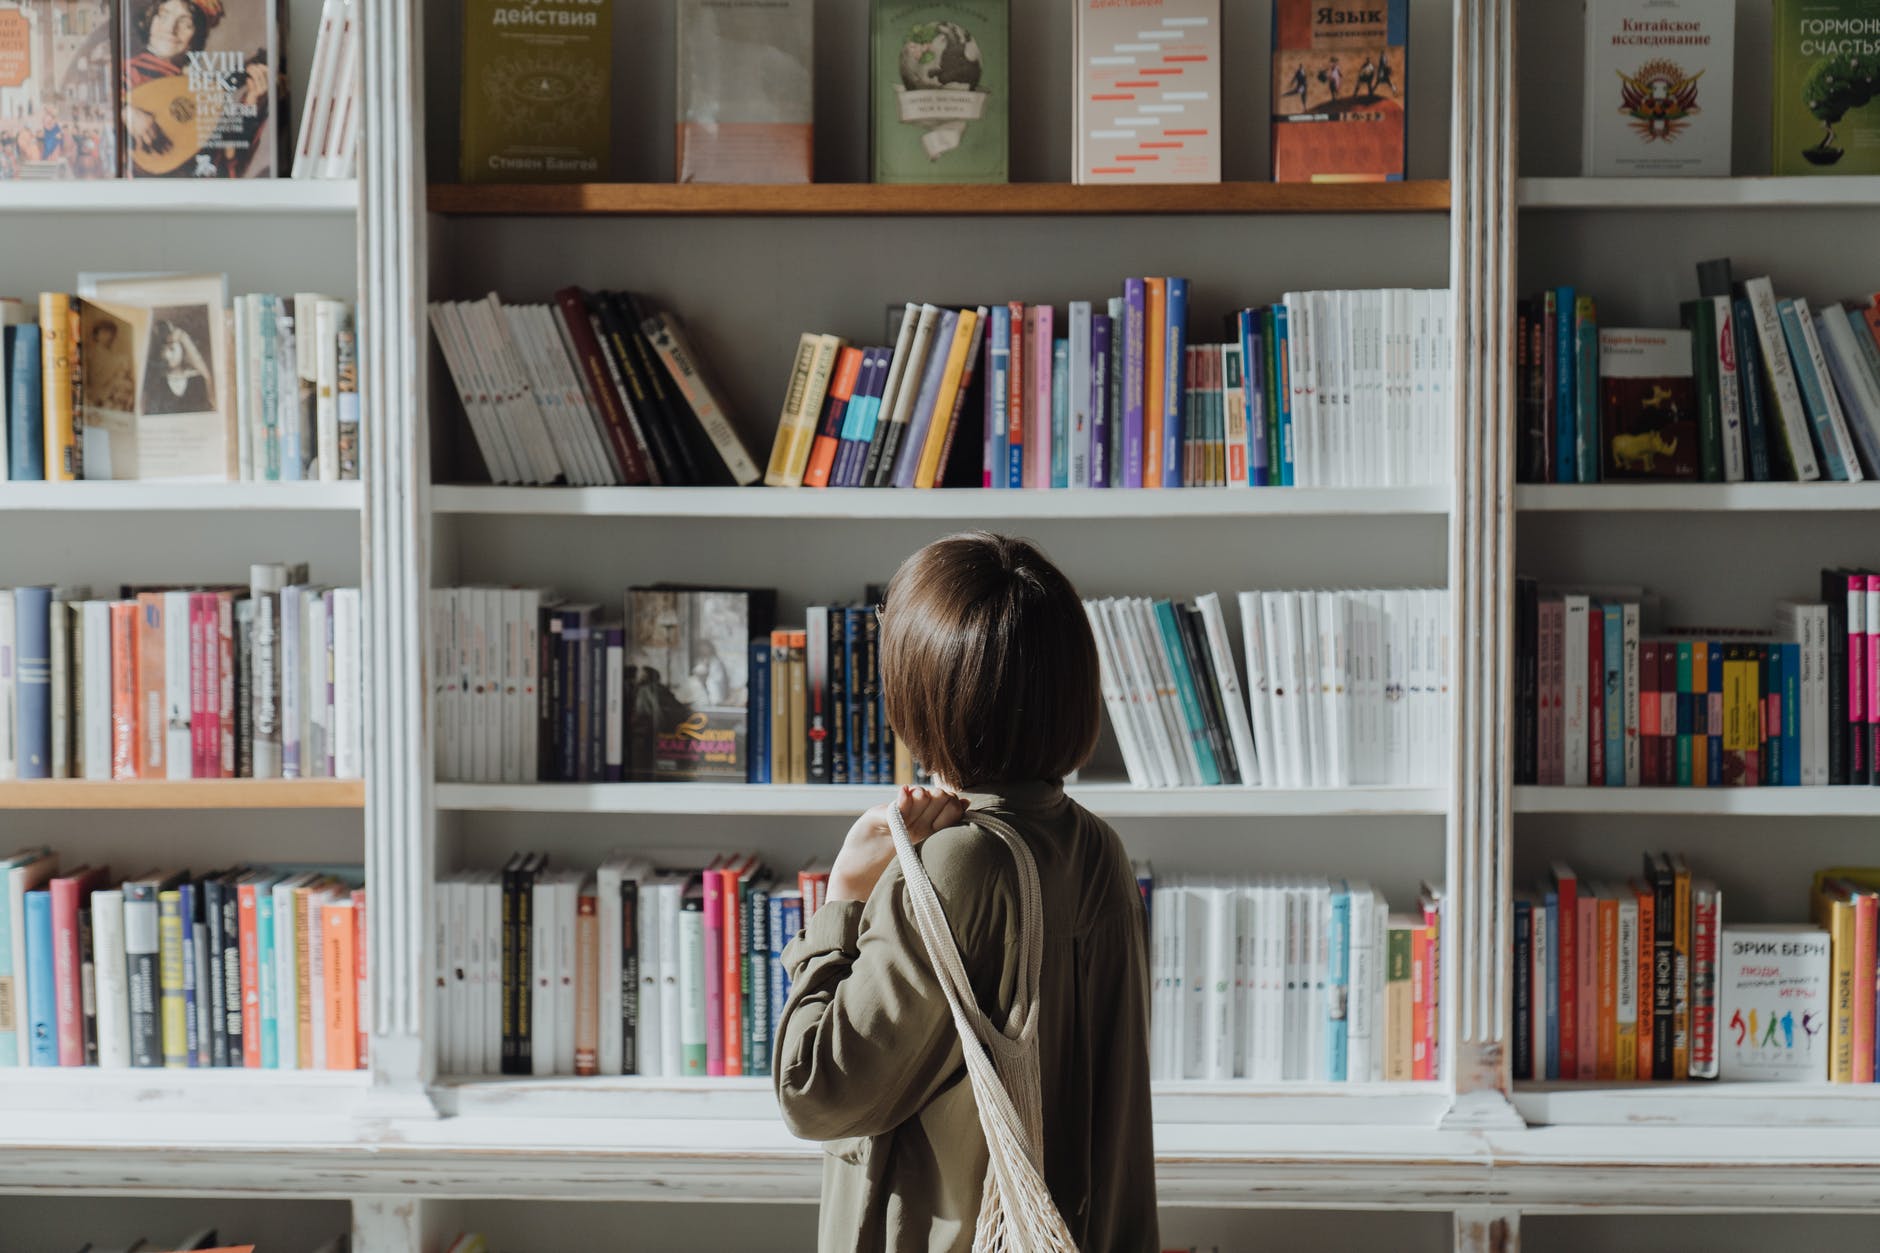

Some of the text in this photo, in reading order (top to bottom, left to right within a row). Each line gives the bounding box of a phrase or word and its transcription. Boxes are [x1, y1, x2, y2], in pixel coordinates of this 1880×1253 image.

[493, 6, 597, 25] действия
[1317, 8, 1382, 24] Язык
[1623, 18, 1700, 31] Китайское
[1611, 34, 1711, 47] исследование
[186, 51, 246, 72] XVIII
[1733, 942, 1825, 956] ЭРИК БЕРН
